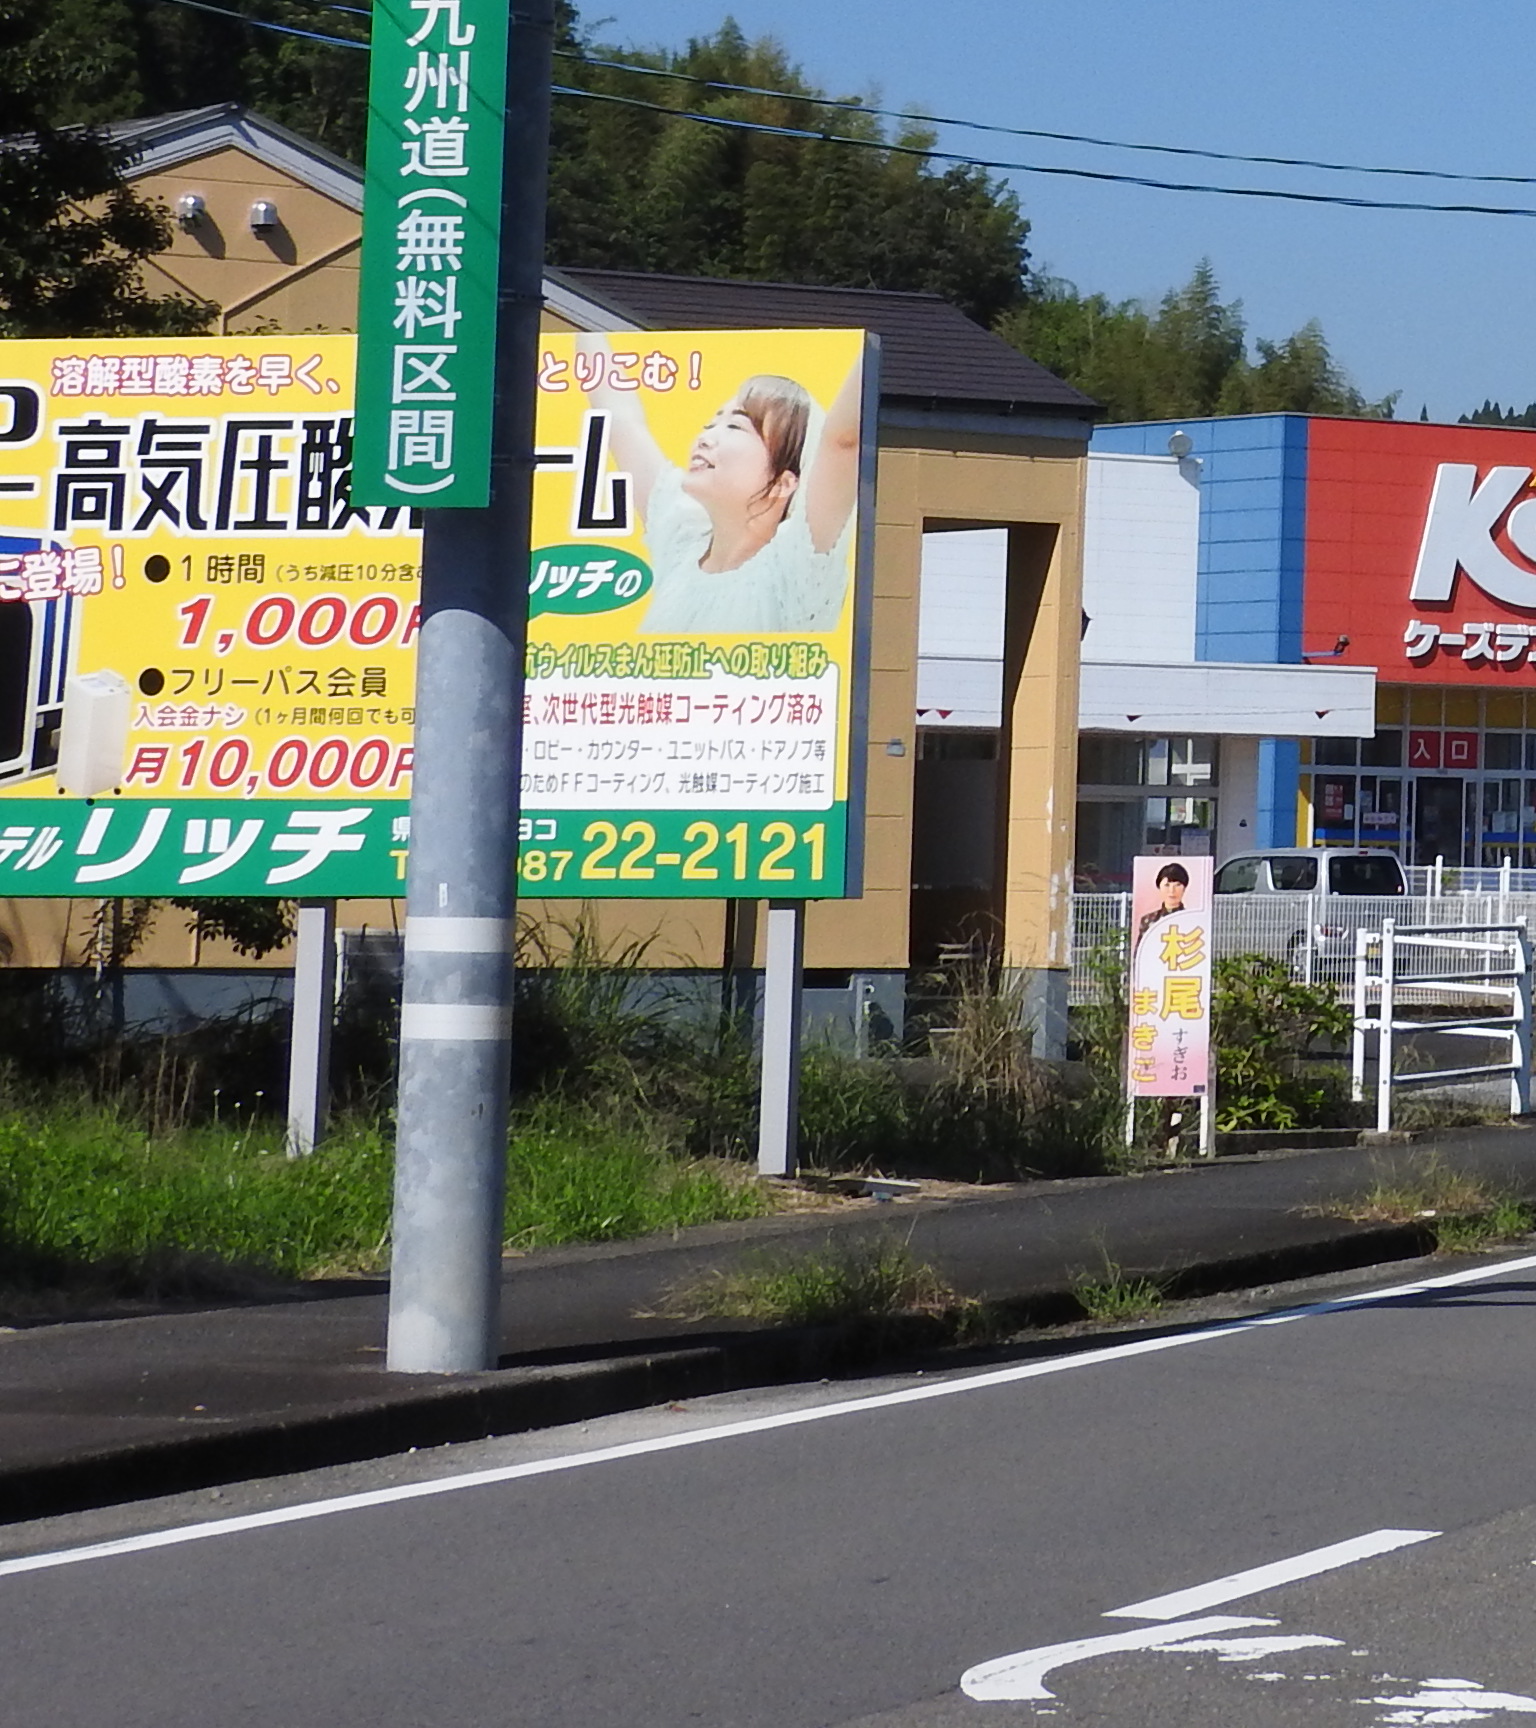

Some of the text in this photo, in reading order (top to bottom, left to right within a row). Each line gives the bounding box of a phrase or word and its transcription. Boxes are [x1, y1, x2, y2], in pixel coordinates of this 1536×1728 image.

[171, 665, 388, 698] フリーパス会員
[133, 706, 246, 729] 入会金ナシ
[1413, 738, 1469, 761] 入口
[75, 807, 374, 885] リッチ
[581, 820, 826, 881] 22-2121
[1160, 924, 1207, 1021] 杉尾
[1131, 987, 1159, 1083] まきこ
[1170, 1027, 1188, 1081] すぎお
